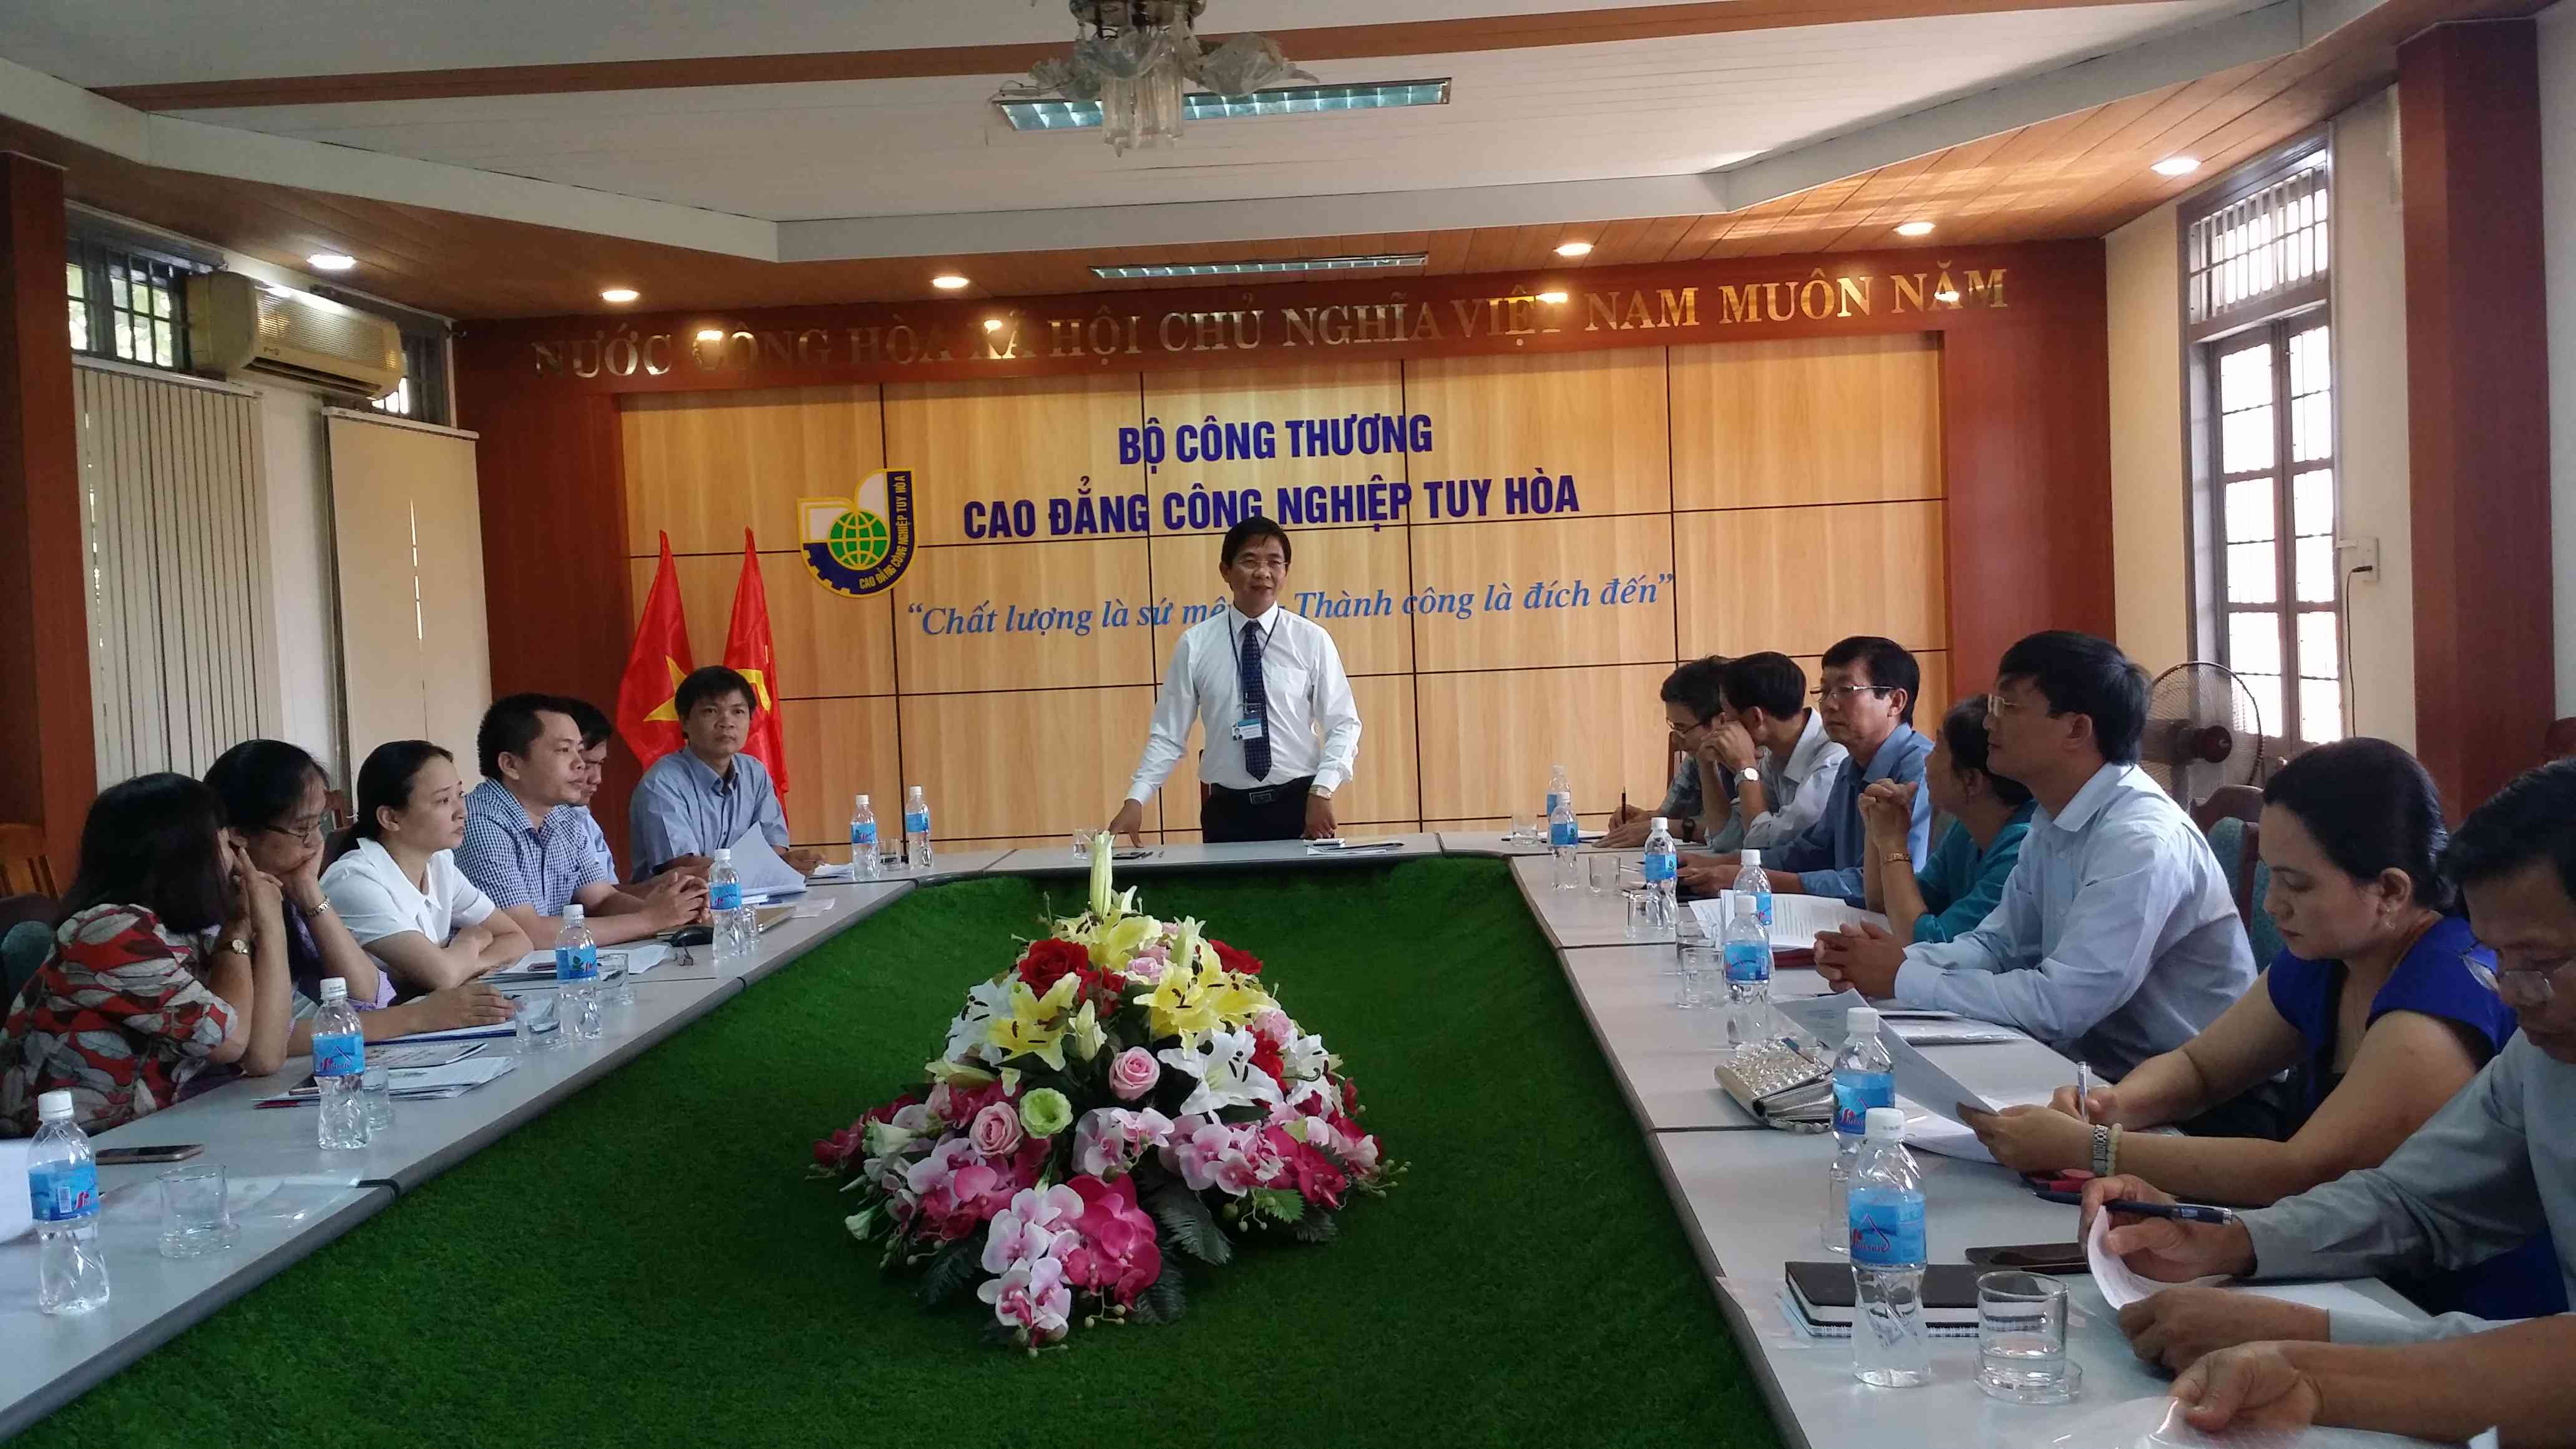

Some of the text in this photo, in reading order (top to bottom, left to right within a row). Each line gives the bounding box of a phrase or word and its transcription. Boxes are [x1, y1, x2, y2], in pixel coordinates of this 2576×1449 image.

[1046, 304, 1143, 366] HỘI
[1158, 291, 1264, 352] CHỦ
[1281, 291, 1443, 347] NGHĨA
[1584, 286, 1700, 331] NAM
[1718, 267, 1873, 324] MUÔN
[1890, 259, 2008, 313] NĂM
[1119, 412, 1433, 474] BỘ CÔNG THƯƠNG
[964, 467, 1580, 539] CAO ĐẲNG CÔNG NGHIỆP TUY HÒA
[859, 575, 876, 590] CAO
[895, 496, 907, 513] TUY
[1005, 605, 1093, 637] lượng
[1101, 598, 1129, 628] là
[1137, 597, 1174, 626] sứ
[1293, 588, 1392, 619] Thành
[1402, 587, 1475, 620] công
[1484, 582, 1513, 612] là
[1523, 579, 1591, 610] đích
